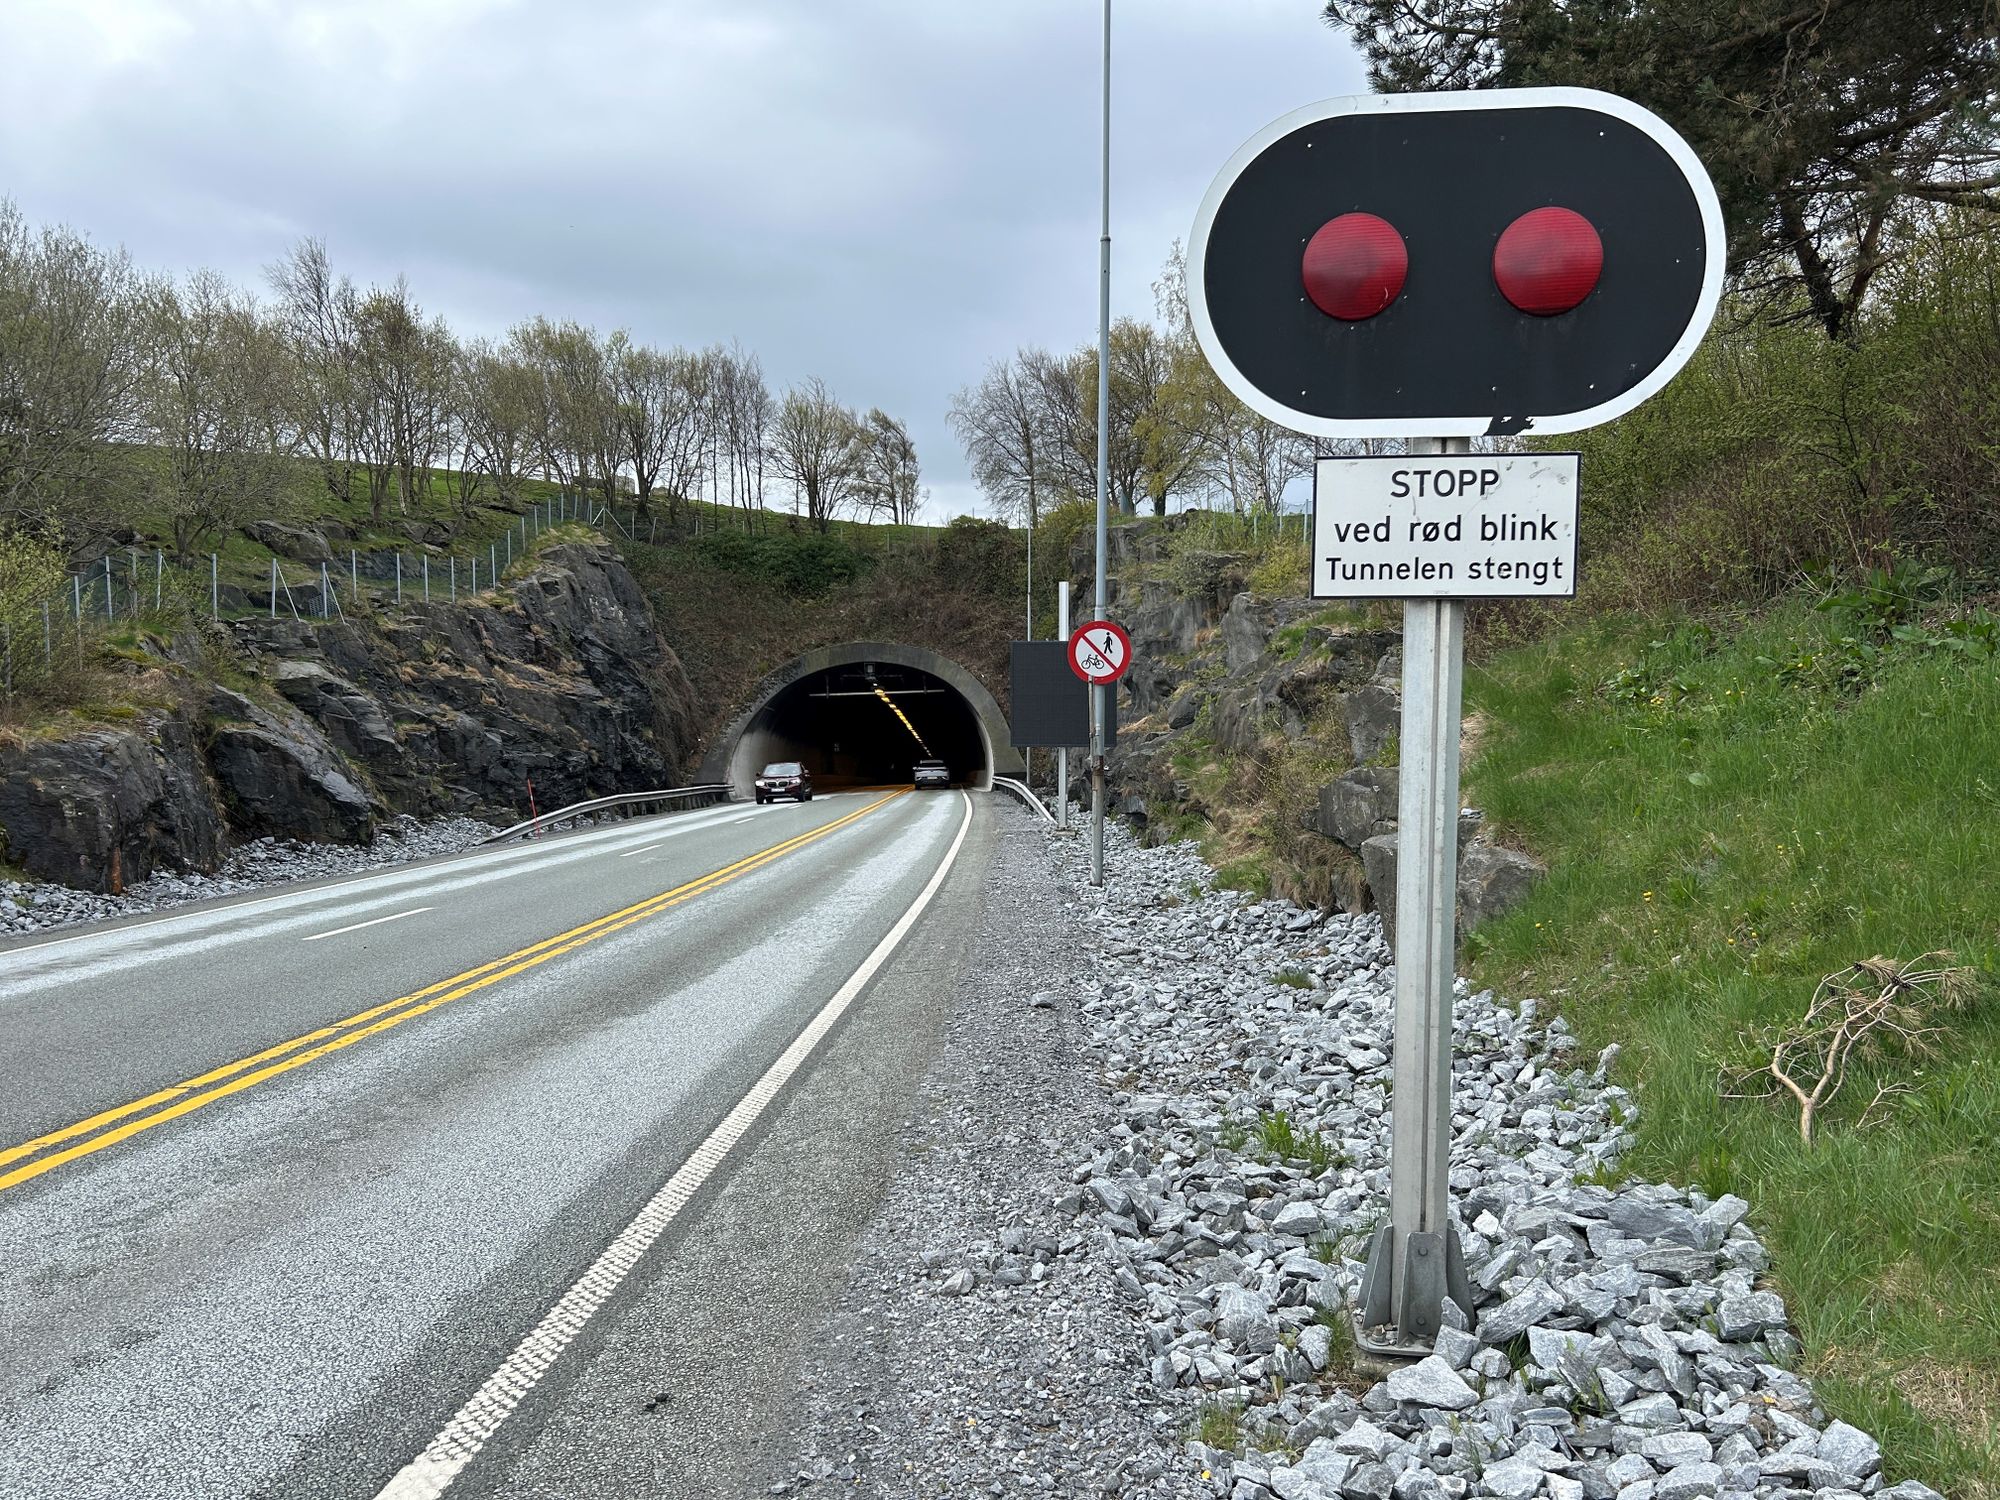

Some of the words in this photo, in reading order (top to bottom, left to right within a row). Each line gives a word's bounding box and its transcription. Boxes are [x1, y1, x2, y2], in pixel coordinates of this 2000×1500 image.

[1390, 469, 1499, 498] STOPP
[1334, 515, 1391, 543] ved
[1409, 514, 1462, 543] rød
[1480, 513, 1559, 542] blink
[1325, 556, 1453, 581] Tunnelen
[1467, 556, 1563, 586] stengt
